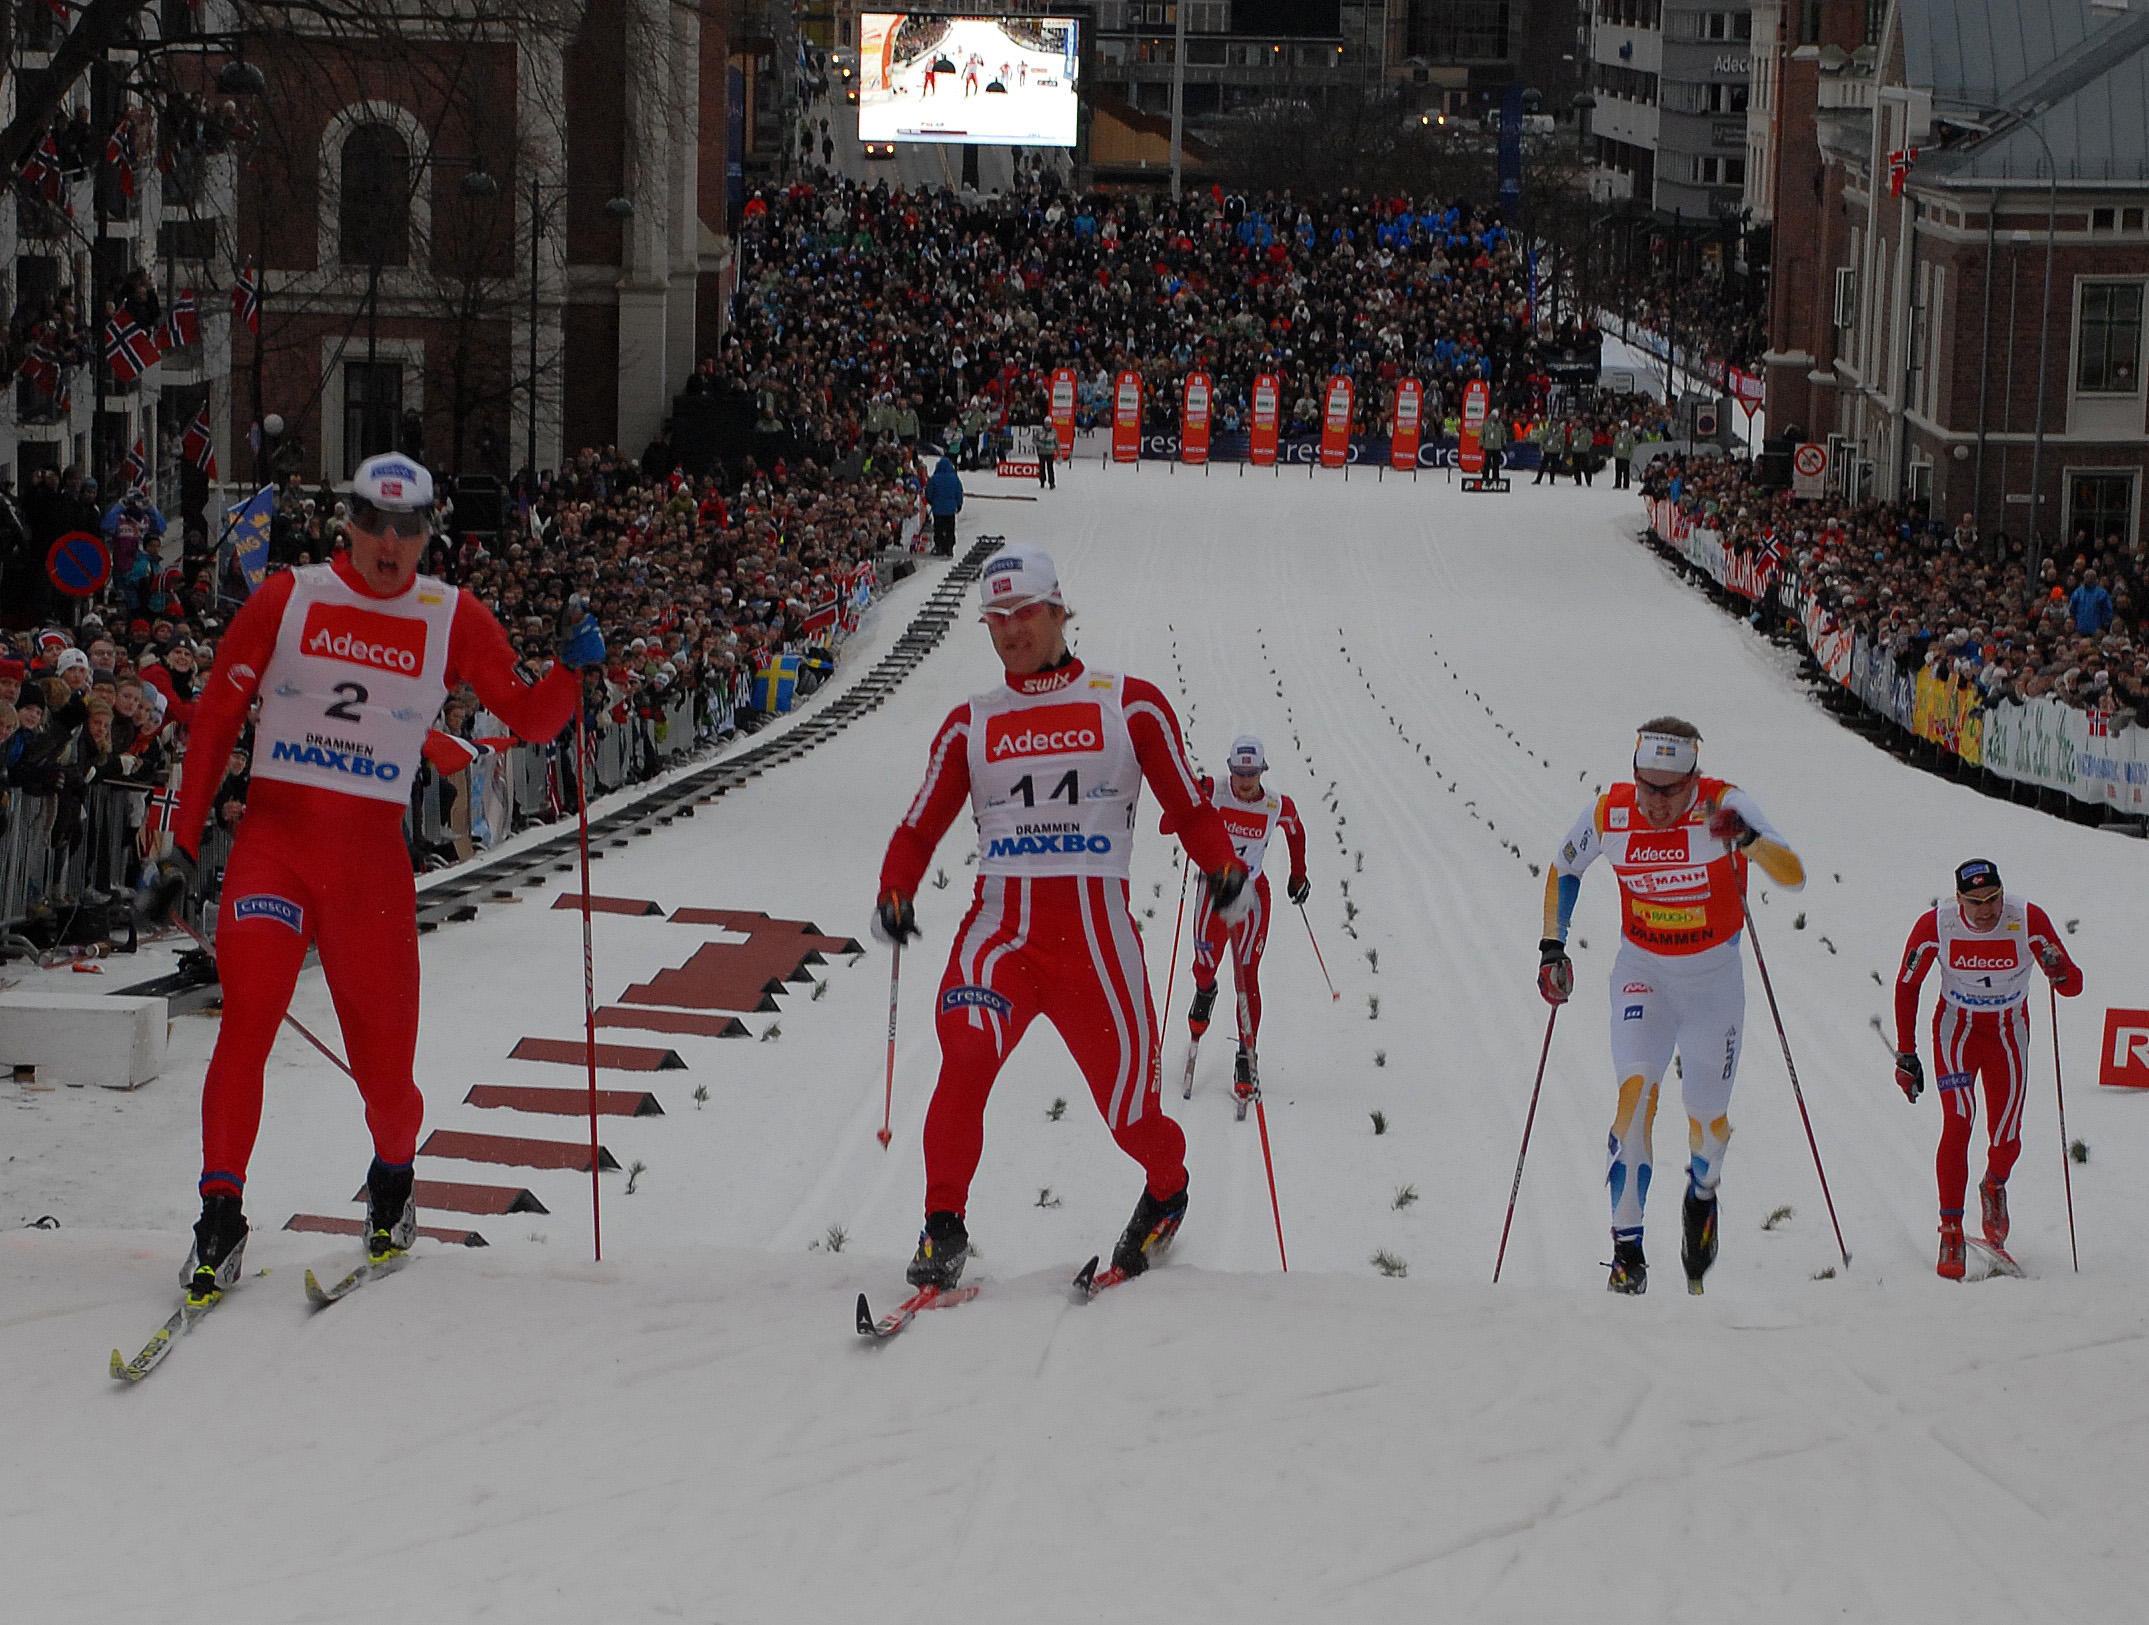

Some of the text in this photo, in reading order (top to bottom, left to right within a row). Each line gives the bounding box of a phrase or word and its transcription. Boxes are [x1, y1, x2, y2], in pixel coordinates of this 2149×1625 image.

[1464, 480, 1507, 491] POLAR
[309, 628, 416, 671] Adecco
[325, 682, 369, 722] 2
[306, 733, 374, 756] DRAMMEN
[993, 729, 1096, 757] Adecco
[272, 741, 400, 780] MAXBO
[1016, 823, 1080, 835] DRAMMEN
[988, 834, 1112, 858] MAXBO
[1630, 847, 1685, 862] Adecco
[1954, 955, 2014, 968] Adecco
[1976, 976, 1991, 988] 1
